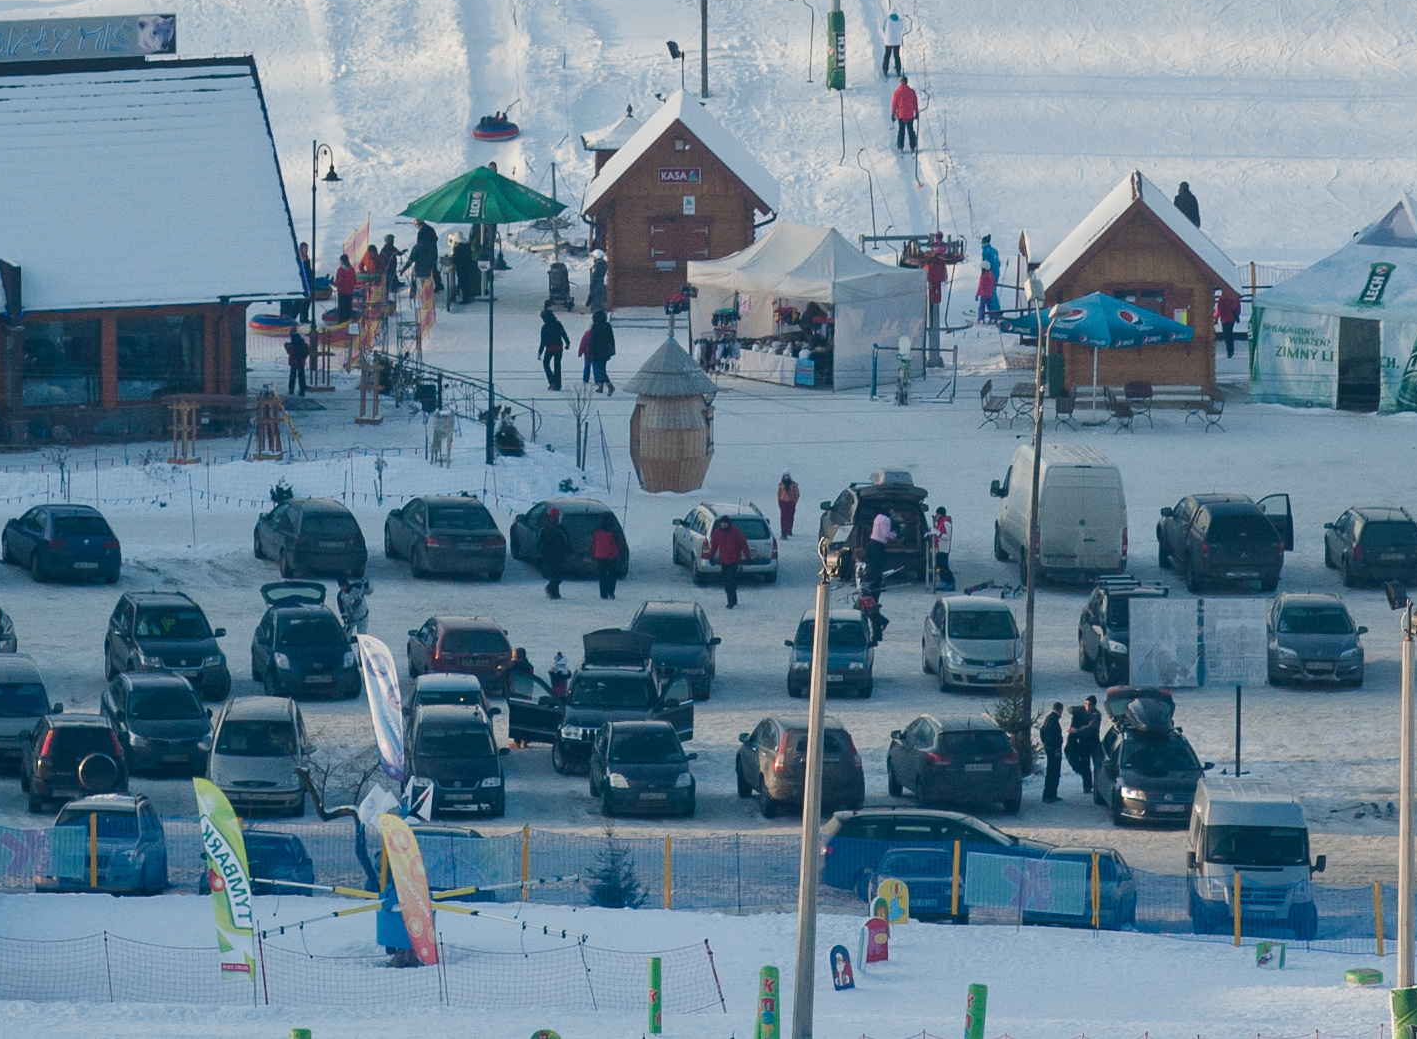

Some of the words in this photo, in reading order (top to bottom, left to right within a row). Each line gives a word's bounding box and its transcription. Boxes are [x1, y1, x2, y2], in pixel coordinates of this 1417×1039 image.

[80, 19, 132, 51] MIŚ
[661, 171, 687, 180] KASA
[469, 197, 482, 217] LECH
[1364, 276, 1385, 301] LECH
[1275, 345, 1319, 360] ZIMNY
